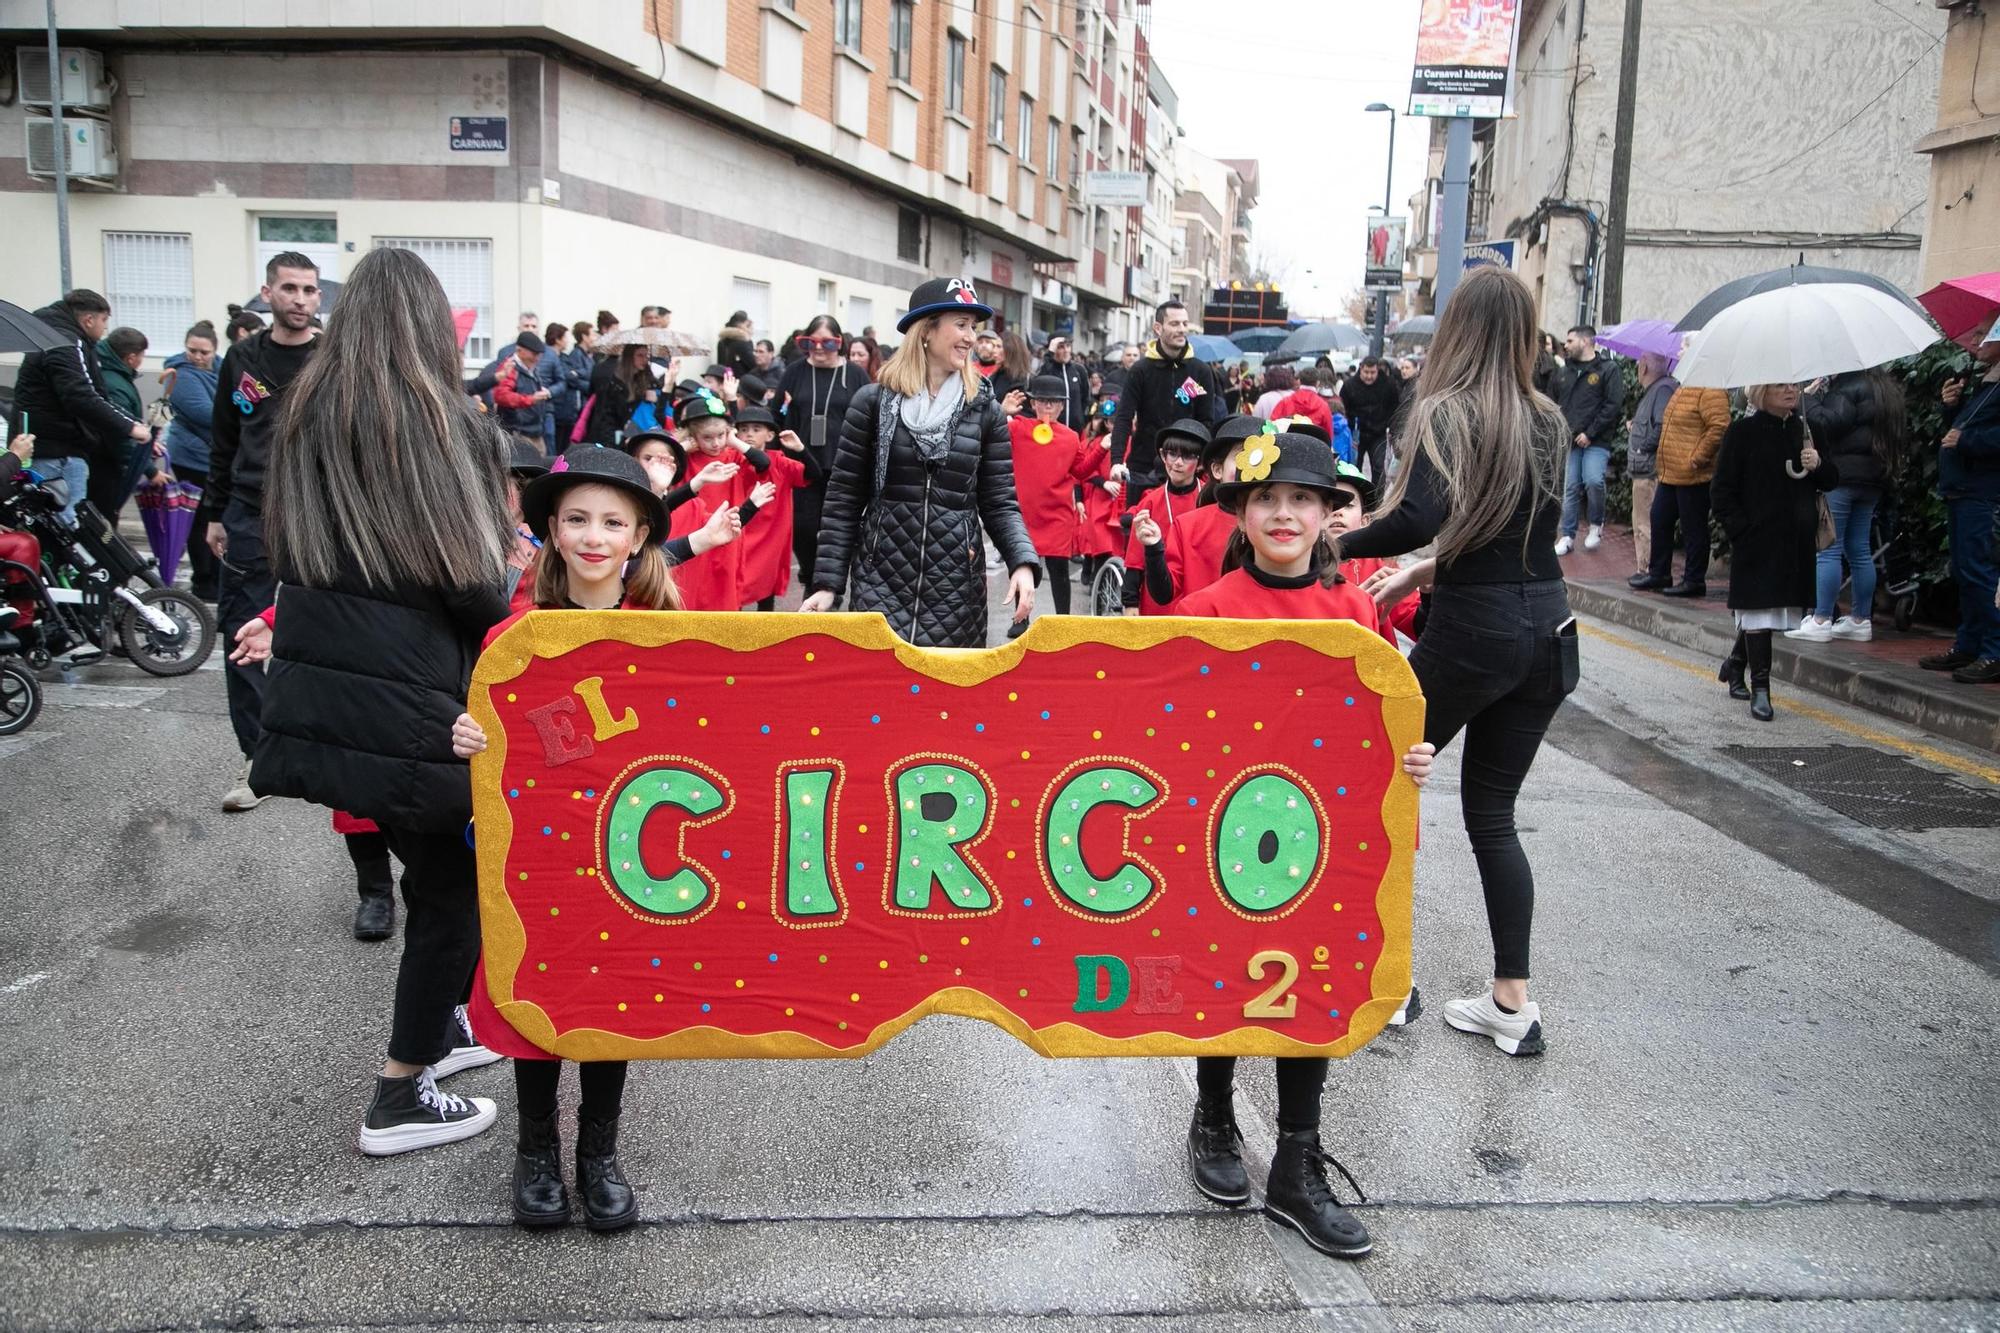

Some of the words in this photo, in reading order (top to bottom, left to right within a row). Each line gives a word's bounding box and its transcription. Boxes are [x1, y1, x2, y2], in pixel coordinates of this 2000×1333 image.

[1424, 69, 1463, 79] Carnaval
[1465, 70, 1504, 80] histórico
[452, 138, 505, 150] CARNAVAL
[525, 676, 640, 768] EL
[606, 763, 1321, 915] CIRCO
[1071, 953, 1184, 1015] DE
